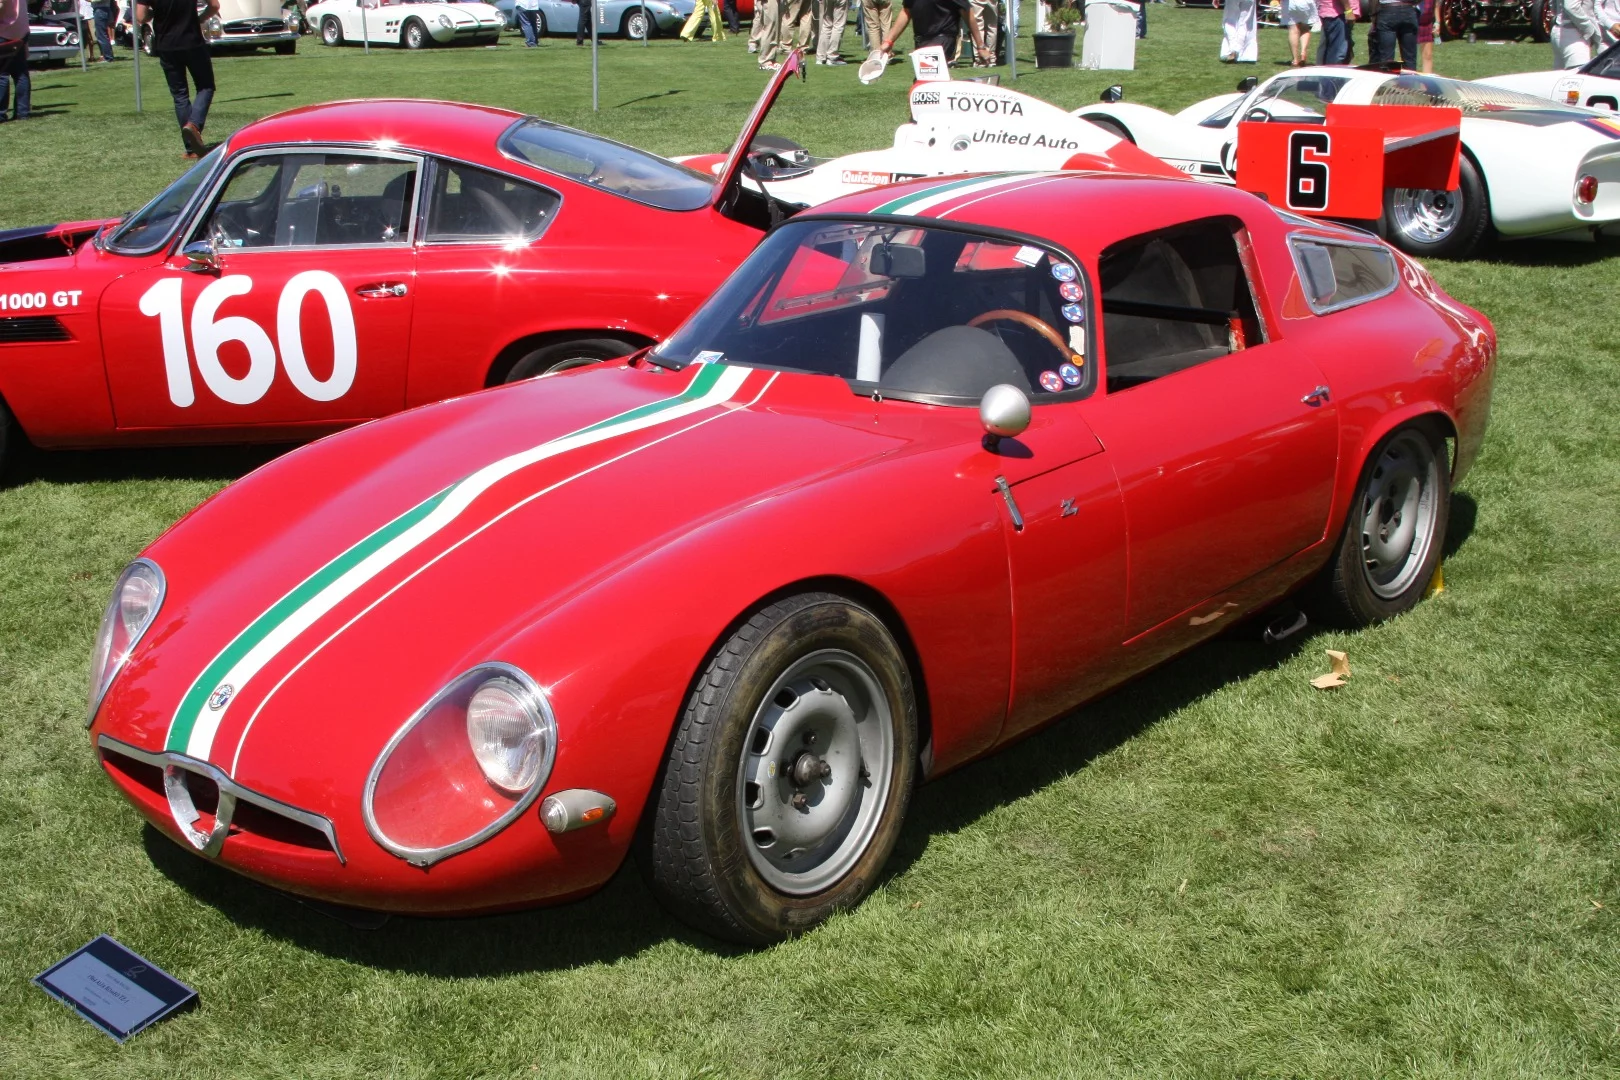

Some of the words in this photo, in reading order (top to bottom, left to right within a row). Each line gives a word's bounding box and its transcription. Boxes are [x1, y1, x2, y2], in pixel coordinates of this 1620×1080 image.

[912, 92, 940, 102] BOSS
[947, 97, 1023, 116] TOYOTA
[972, 130, 1031, 145] United
[1033, 134, 1079, 149] Auto
[842, 170, 889, 184] Quicken
[1286, 130, 1331, 211] 6
[0, 293, 47, 310] 1000
[52, 290, 83, 307] GT
[139, 270, 357, 407] 160
